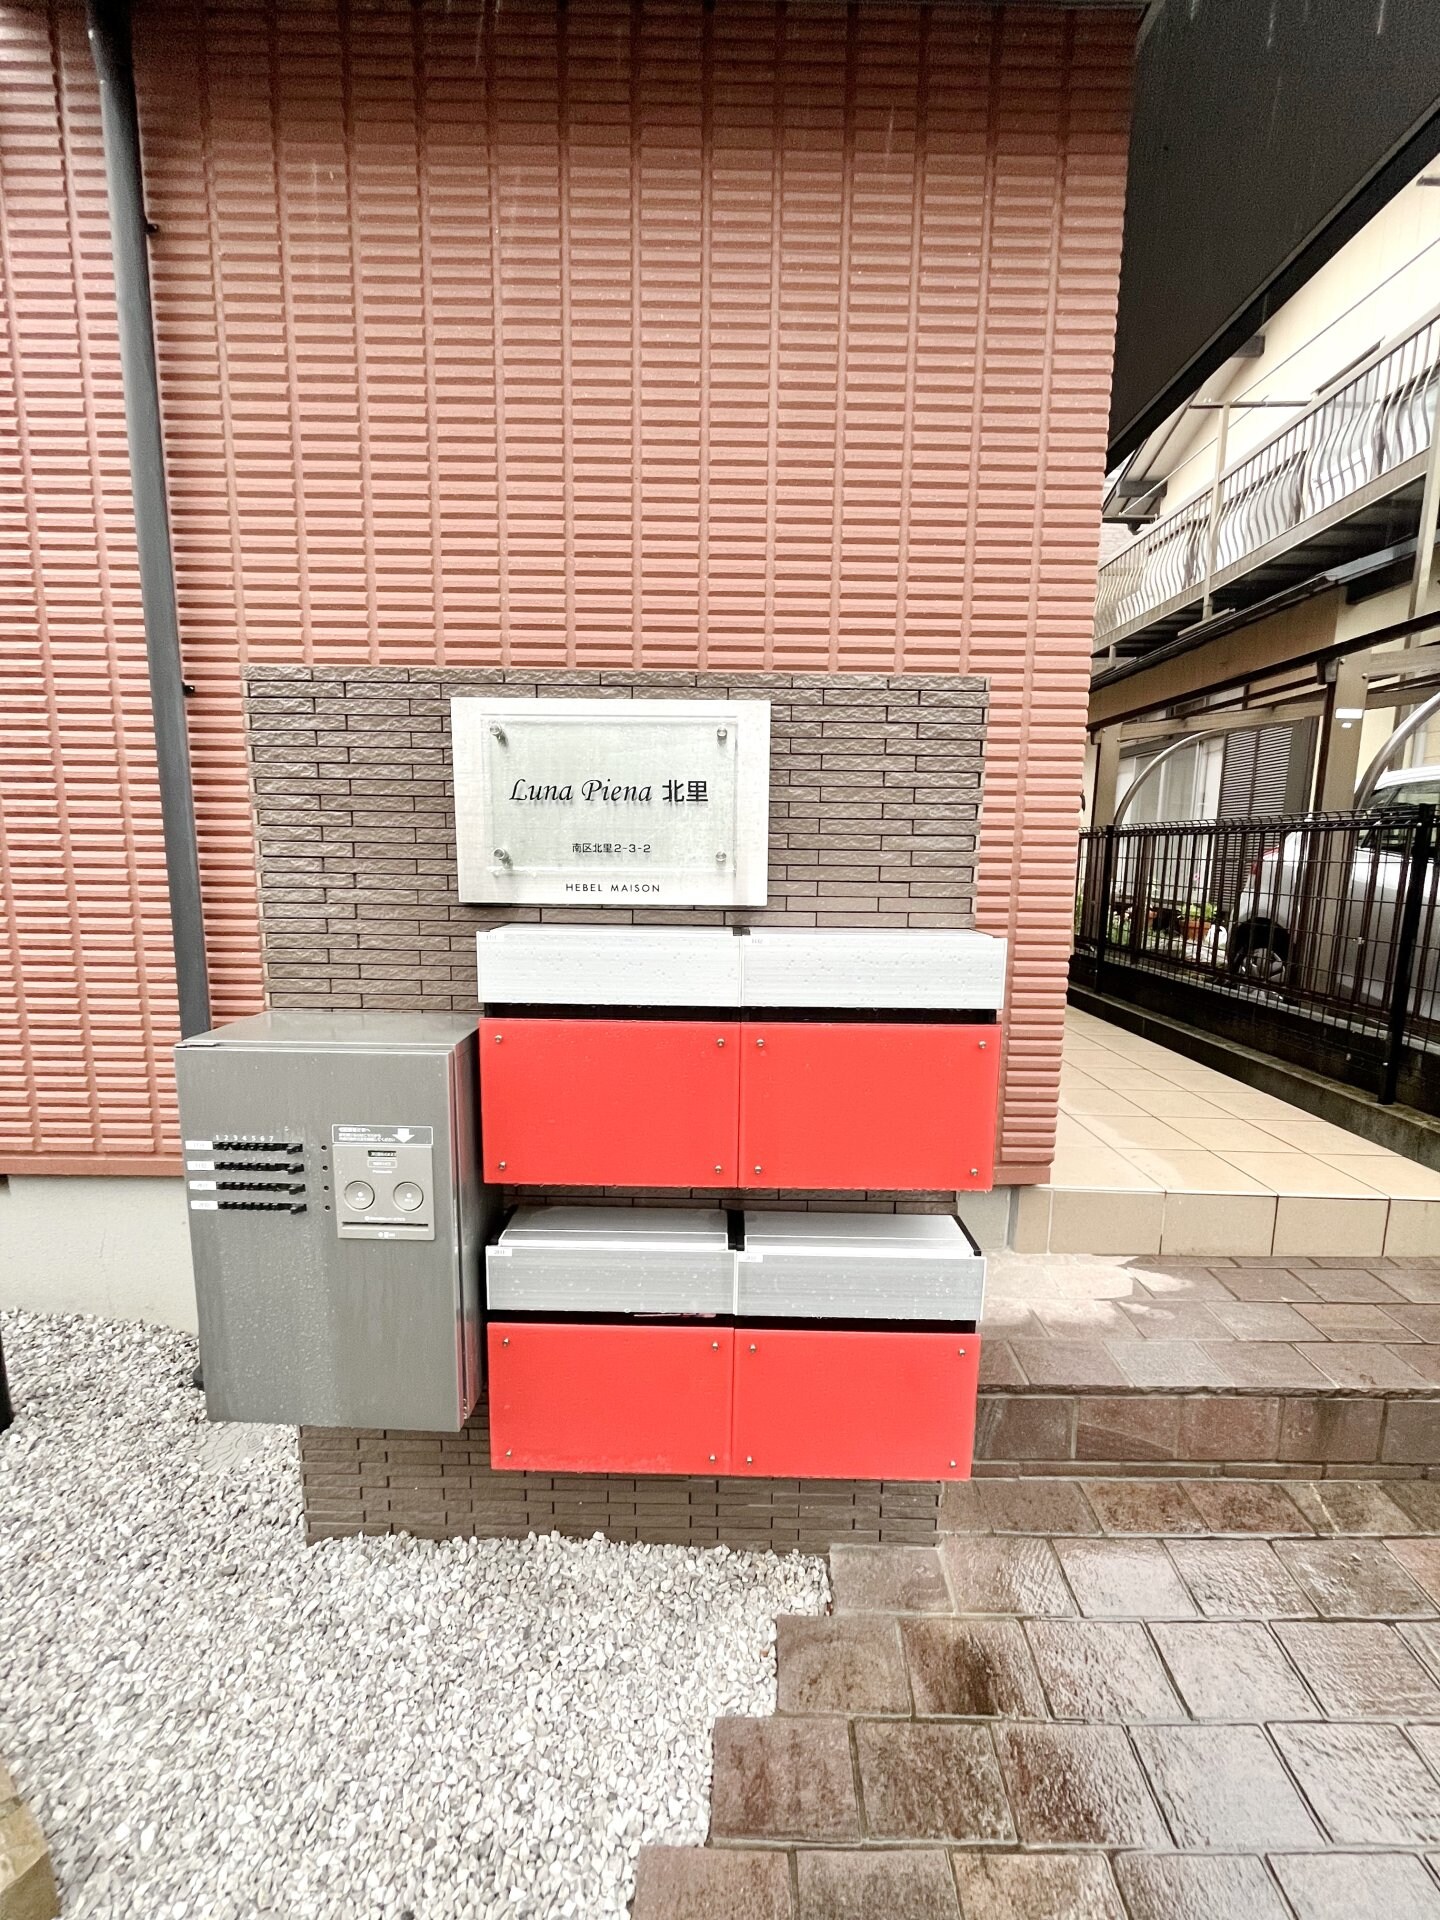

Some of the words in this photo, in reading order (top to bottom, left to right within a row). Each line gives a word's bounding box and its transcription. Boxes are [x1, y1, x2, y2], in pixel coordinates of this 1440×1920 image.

[509, 778, 573, 801] Luna
[581, 778, 652, 801] Piena
[662, 779, 709, 802] 北里
[572, 843, 651, 853] 南区北里2-3-2
[565, 883, 603, 892] HEBEL
[610, 884, 660, 893] MAISON
